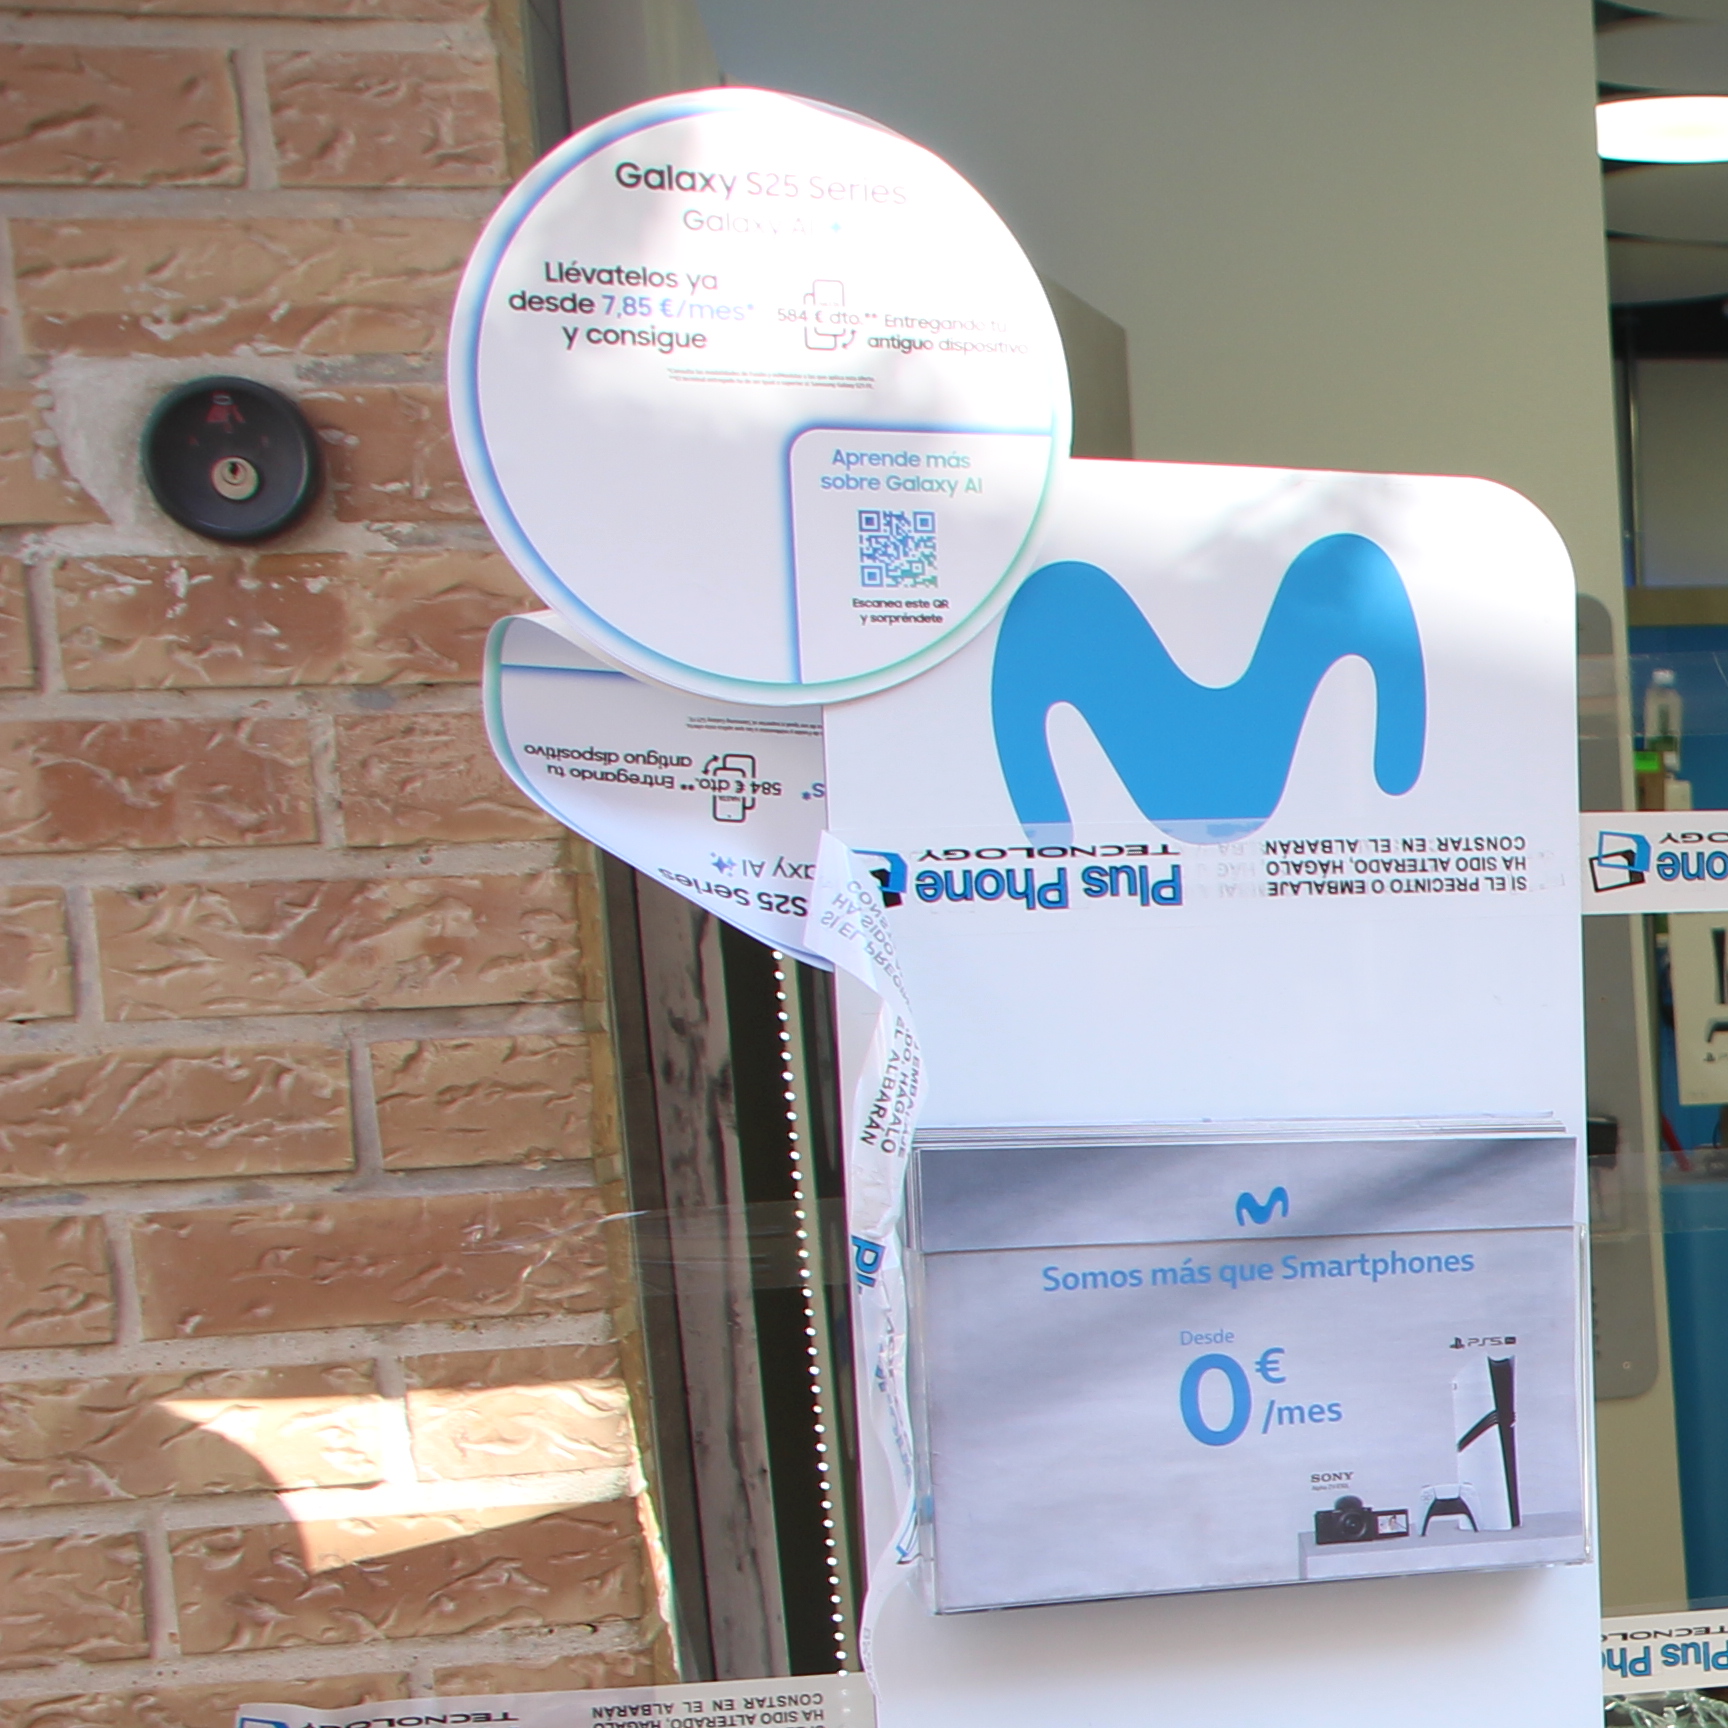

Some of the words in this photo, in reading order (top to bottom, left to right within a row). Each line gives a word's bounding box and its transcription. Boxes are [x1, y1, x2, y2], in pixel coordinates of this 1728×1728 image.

[615, 161, 736, 198] Galaxy
[746, 171, 798, 198] S25
[545, 261, 677, 288] Llévatelos
[686, 270, 718, 294] ya
[509, 291, 595, 314] desde
[601, 293, 651, 319] 7,85
[562, 327, 579, 349] y
[586, 323, 707, 352] consigue
[868, 334, 933, 354] antiguo
[831, 448, 920, 473] Aprende
[925, 448, 970, 469] más
[821, 472, 880, 492] sobre
[885, 473, 958, 497] Galaxy
[964, 477, 982, 494] AI
[852, 598, 900, 609] Escanea
[905, 599, 929, 609] este
[933, 598, 949, 609] QR
[860, 614, 867, 624] y
[871, 611, 943, 625] sorpréndete
[524, 742, 619, 766] dispositivo
[624, 748, 693, 770] antiguo
[548, 764, 564, 778] tu
[569, 767, 675, 789] Entregando
[735, 781, 746, 794] €
[756, 781, 782, 796] 584
[916, 843, 1179, 863] TECNOLOGY
[658, 866, 750, 907] Series
[915, 865, 1069, 910] Phone
[1084, 863, 1182, 907] Plus
[759, 891, 808, 917] S25
[1043, 1263, 1143, 1293] Somos
[1152, 1258, 1212, 1287] más
[1219, 1259, 1273, 1289] que
[1282, 1249, 1474, 1285] Smartphones
[1180, 1328, 1235, 1346] Desde
[1255, 1347, 1286, 1384] €
[1179, 1353, 1252, 1447] 0
[1261, 1398, 1343, 1434] /mes
[1311, 1472, 1354, 1483] SONY
